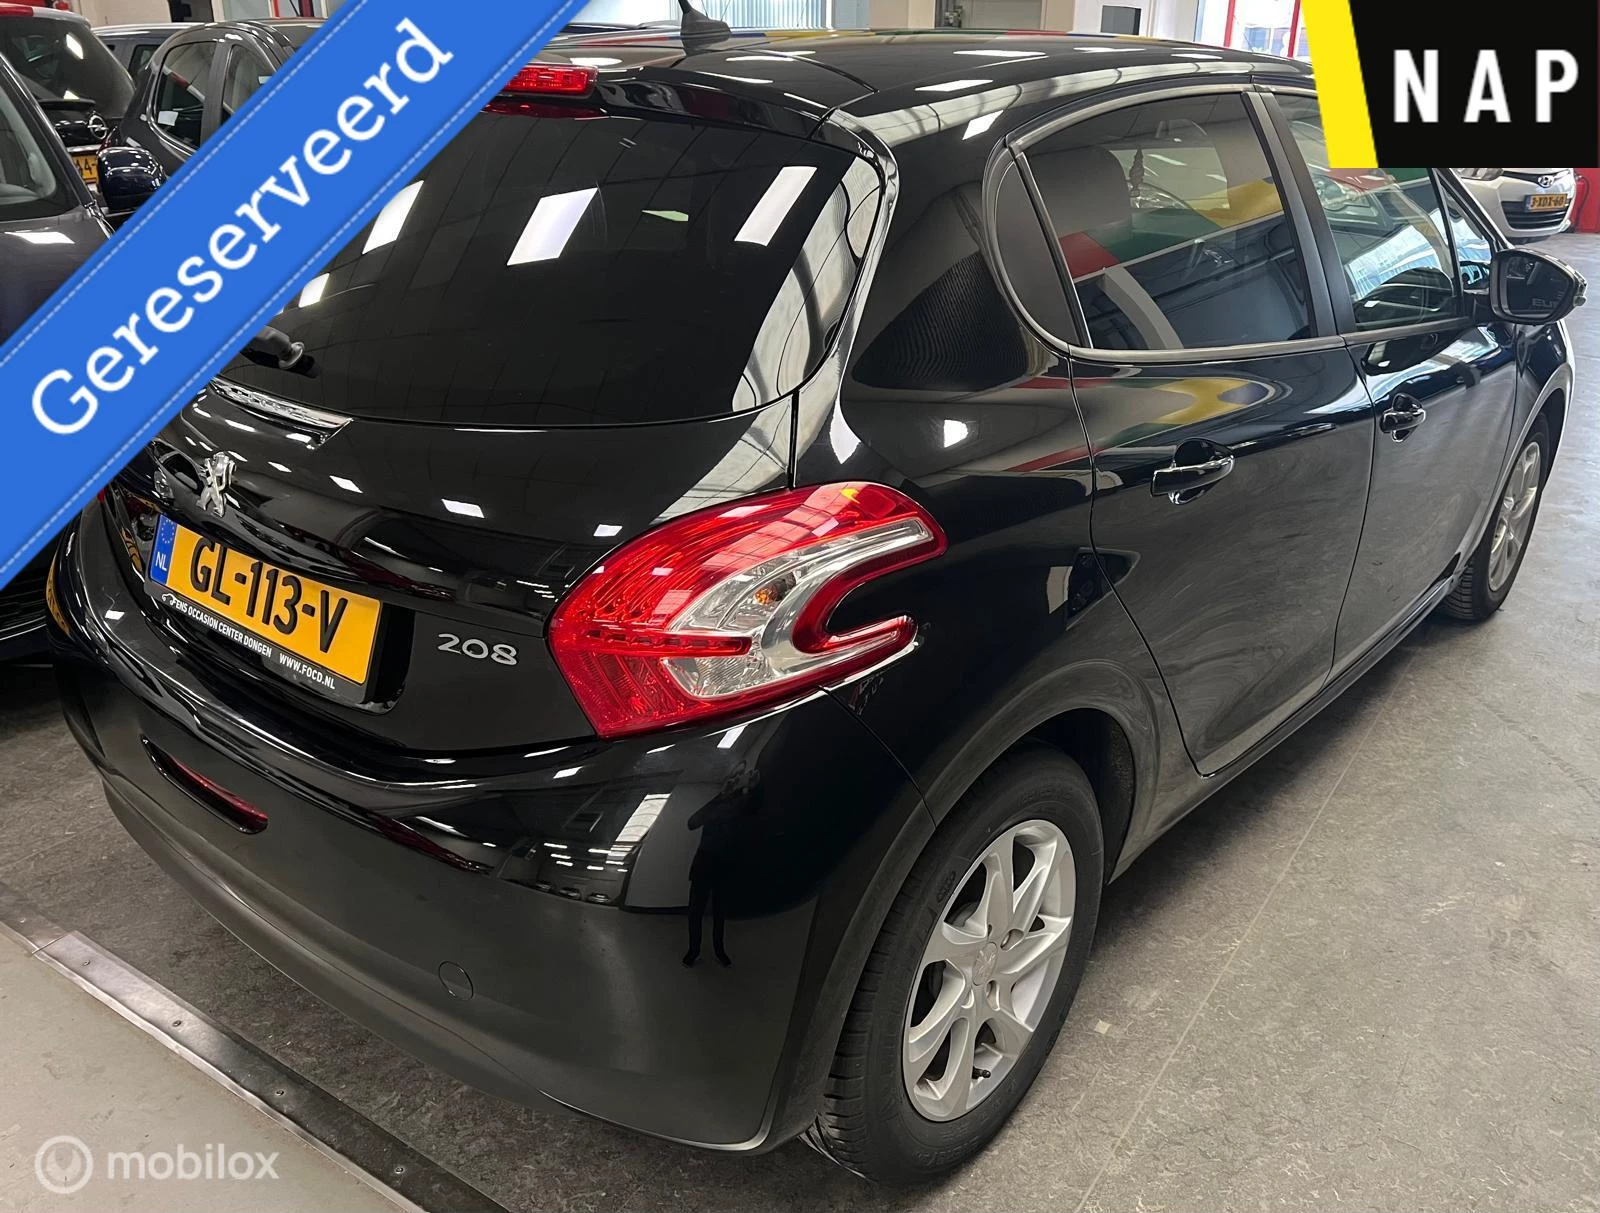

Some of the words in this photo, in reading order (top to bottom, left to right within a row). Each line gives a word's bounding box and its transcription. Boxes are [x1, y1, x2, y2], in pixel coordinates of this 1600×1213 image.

[155, 551, 168, 572] NL
[189, 537, 348, 653] GL-113-V
[188, 606, 218, 630] OCCASION
[218, 621, 244, 643] CENTER
[243, 634, 272, 658] DONGEN
[279, 652, 336, 690] WWW.FOCD.NL
[438, 633, 518, 666] 208
